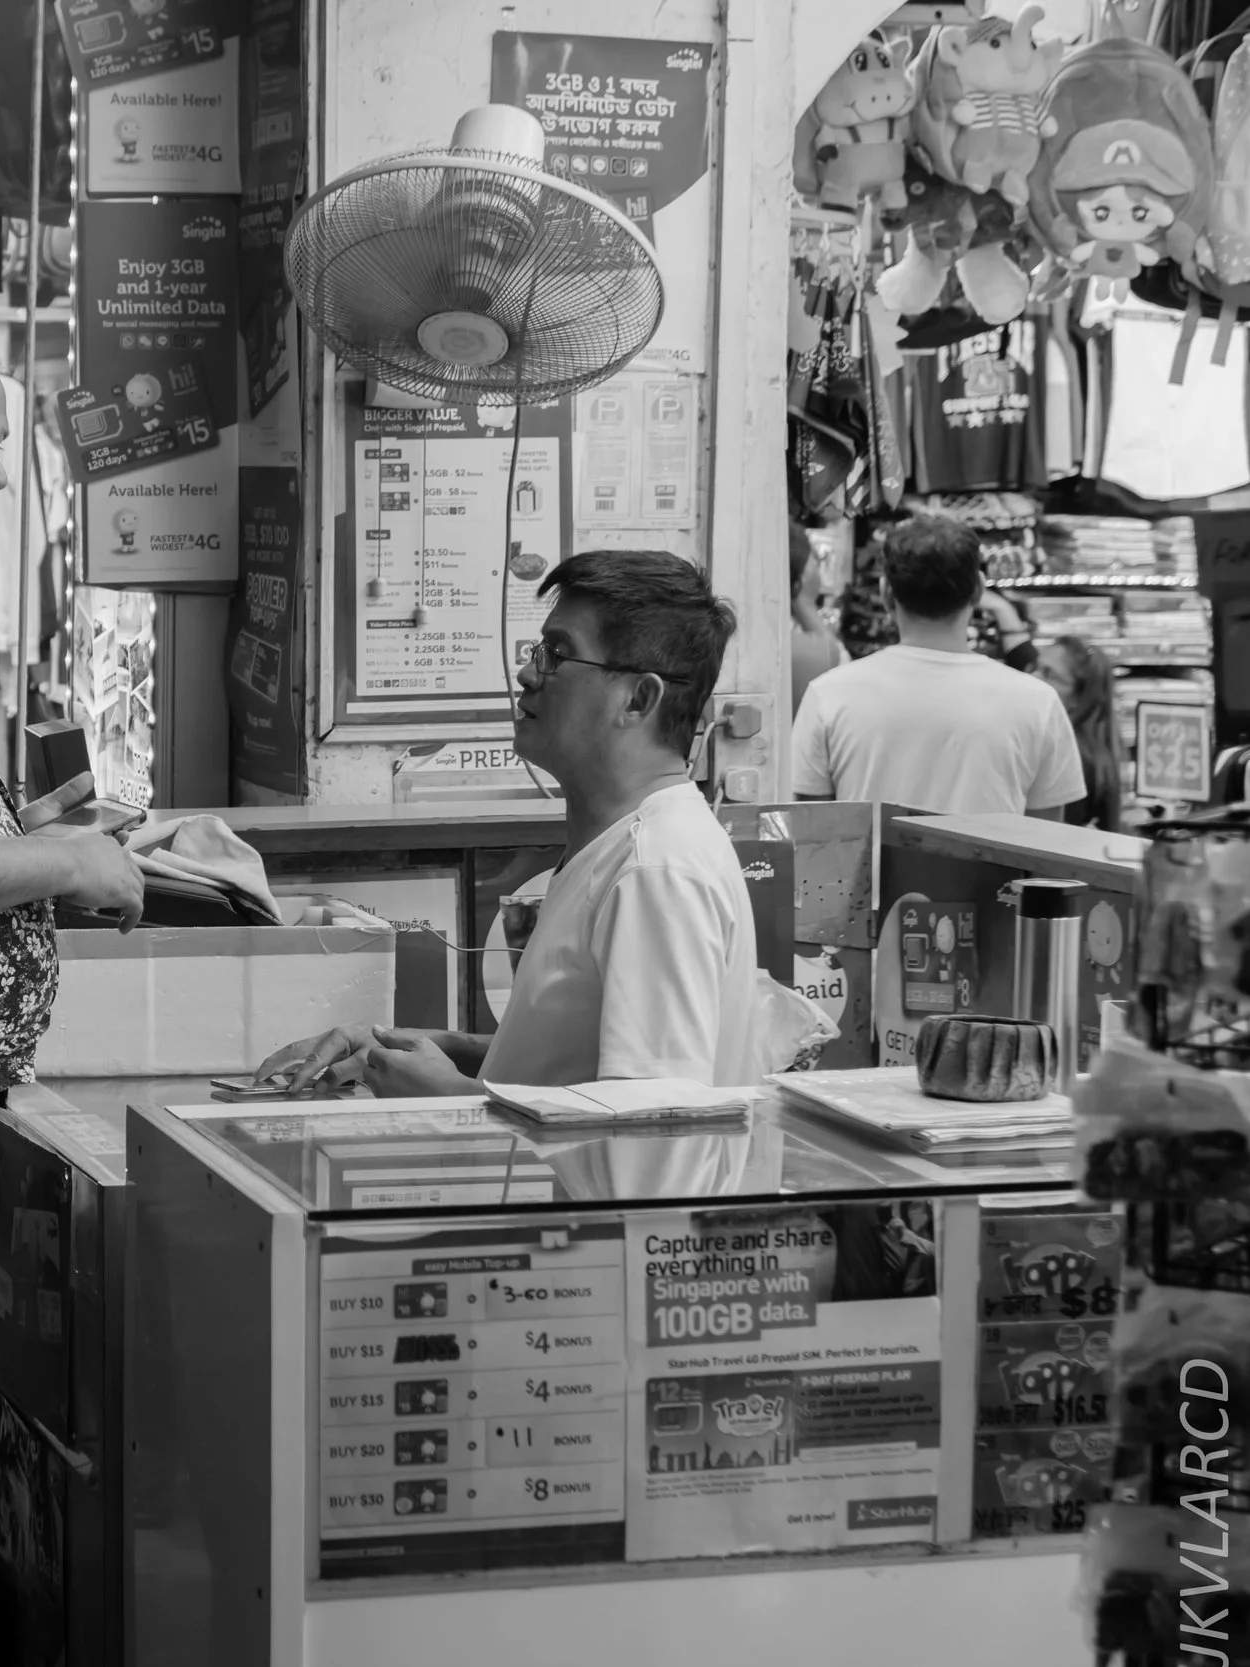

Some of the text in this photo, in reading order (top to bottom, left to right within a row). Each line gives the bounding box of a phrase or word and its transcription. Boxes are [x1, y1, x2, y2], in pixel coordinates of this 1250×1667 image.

[666, 54, 703, 71] Singtel
[545, 73, 583, 92] 3GB
[606, 76, 616, 94] 1
[110, 91, 222, 107] Available Here!
[196, 145, 223, 162] 4G
[183, 224, 226, 241] Singtel
[118, 259, 205, 278] Enjoy 3GB
[117, 280, 207, 298] and 1-year
[97, 299, 226, 315] Unlimited Data
[102, 320, 113, 328] for
[115, 320, 137, 328] social
[168, 363, 197, 391] hi!
[66, 394, 96, 410] Singtel
[364, 408, 461, 421] BIGGER VALUE.
[176, 418, 210, 445] $15
[385, 423, 402, 432] with
[433, 422, 467, 433] Prepaid.
[89, 446, 111, 460] 3GB
[87, 453, 127, 471] 120 days
[108, 483, 218, 497] Available Here!
[194, 534, 221, 550] 4G
[424, 548, 449, 557] $3.50
[424, 560, 440, 569] $11
[246, 572, 288, 611] POWER
[424, 579, 436, 587] $4
[424, 589, 443, 597] 2GB
[449, 588, 461, 597] $4
[424, 599, 443, 608] 4GB
[449, 598, 461, 607] $8
[414, 632, 445, 641] 2.25GB
[452, 631, 476, 640] $3.50
[414, 645, 445, 653] 2.25GB
[414, 658, 433, 667] 6GB
[439, 657, 455, 666] $12
[435, 757, 457, 769] Singtel
[1149, 745, 1199, 780] $25
[885, 1029, 907, 1051] GET
[645, 1228, 833, 1257] Capture and share
[424, 1257, 520, 1273] easy Mobile Top-up
[645, 1252, 779, 1278] everything in
[654, 1272, 810, 1302] Singapore with
[330, 1287, 591, 1311] BUY $10 BONUS
[654, 1301, 810, 1340] 100GB data.
[330, 1331, 592, 1359] BUY $15 $4 BONUS
[668, 1357, 710, 1370] StarHub
[712, 1355, 744, 1367] Travel
[761, 1353, 800, 1366] Prepaid
[825, 1348, 861, 1360] Perfect
[863, 1346, 877, 1356] for
[879, 1344, 921, 1356] tourists.
[833, 1372, 880, 1384] PREPAID
[881, 1369, 912, 1382] PLAN
[330, 1379, 592, 1408] BUY $15 $4 BONUS
[330, 1435, 591, 1459] BUY $20 BONUS
[330, 1478, 591, 1508] BUY $30 $8 BONUS
[787, 1511, 836, 1525] Get it now!
[868, 1505, 933, 1520] StarHub
[1052, 1499, 1086, 1530] $25
